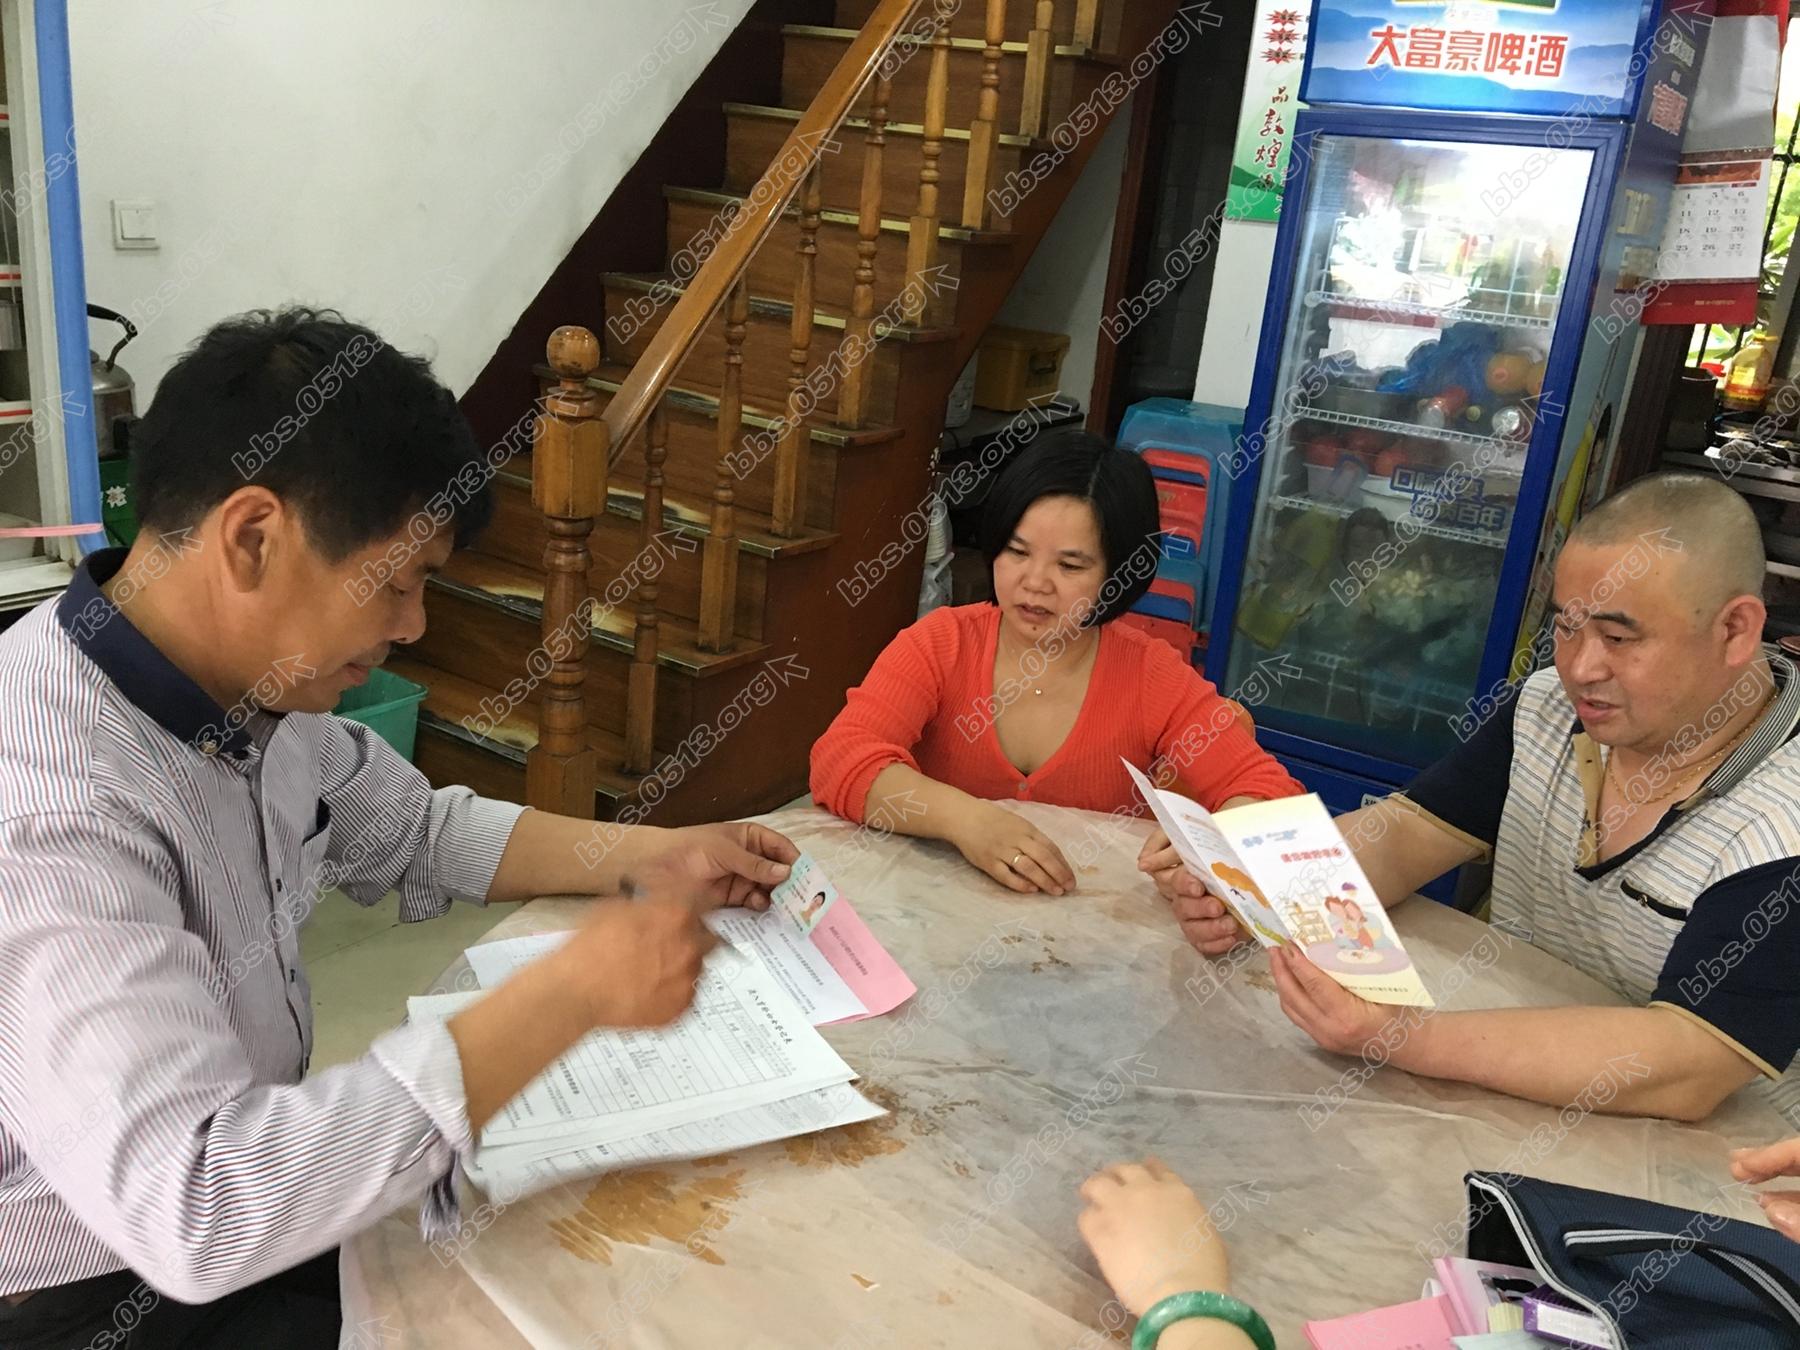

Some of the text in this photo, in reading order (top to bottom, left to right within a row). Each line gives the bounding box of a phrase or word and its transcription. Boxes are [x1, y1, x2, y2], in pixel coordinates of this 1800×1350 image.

[1367, 25, 1569, 78] 大富豪啤酒
